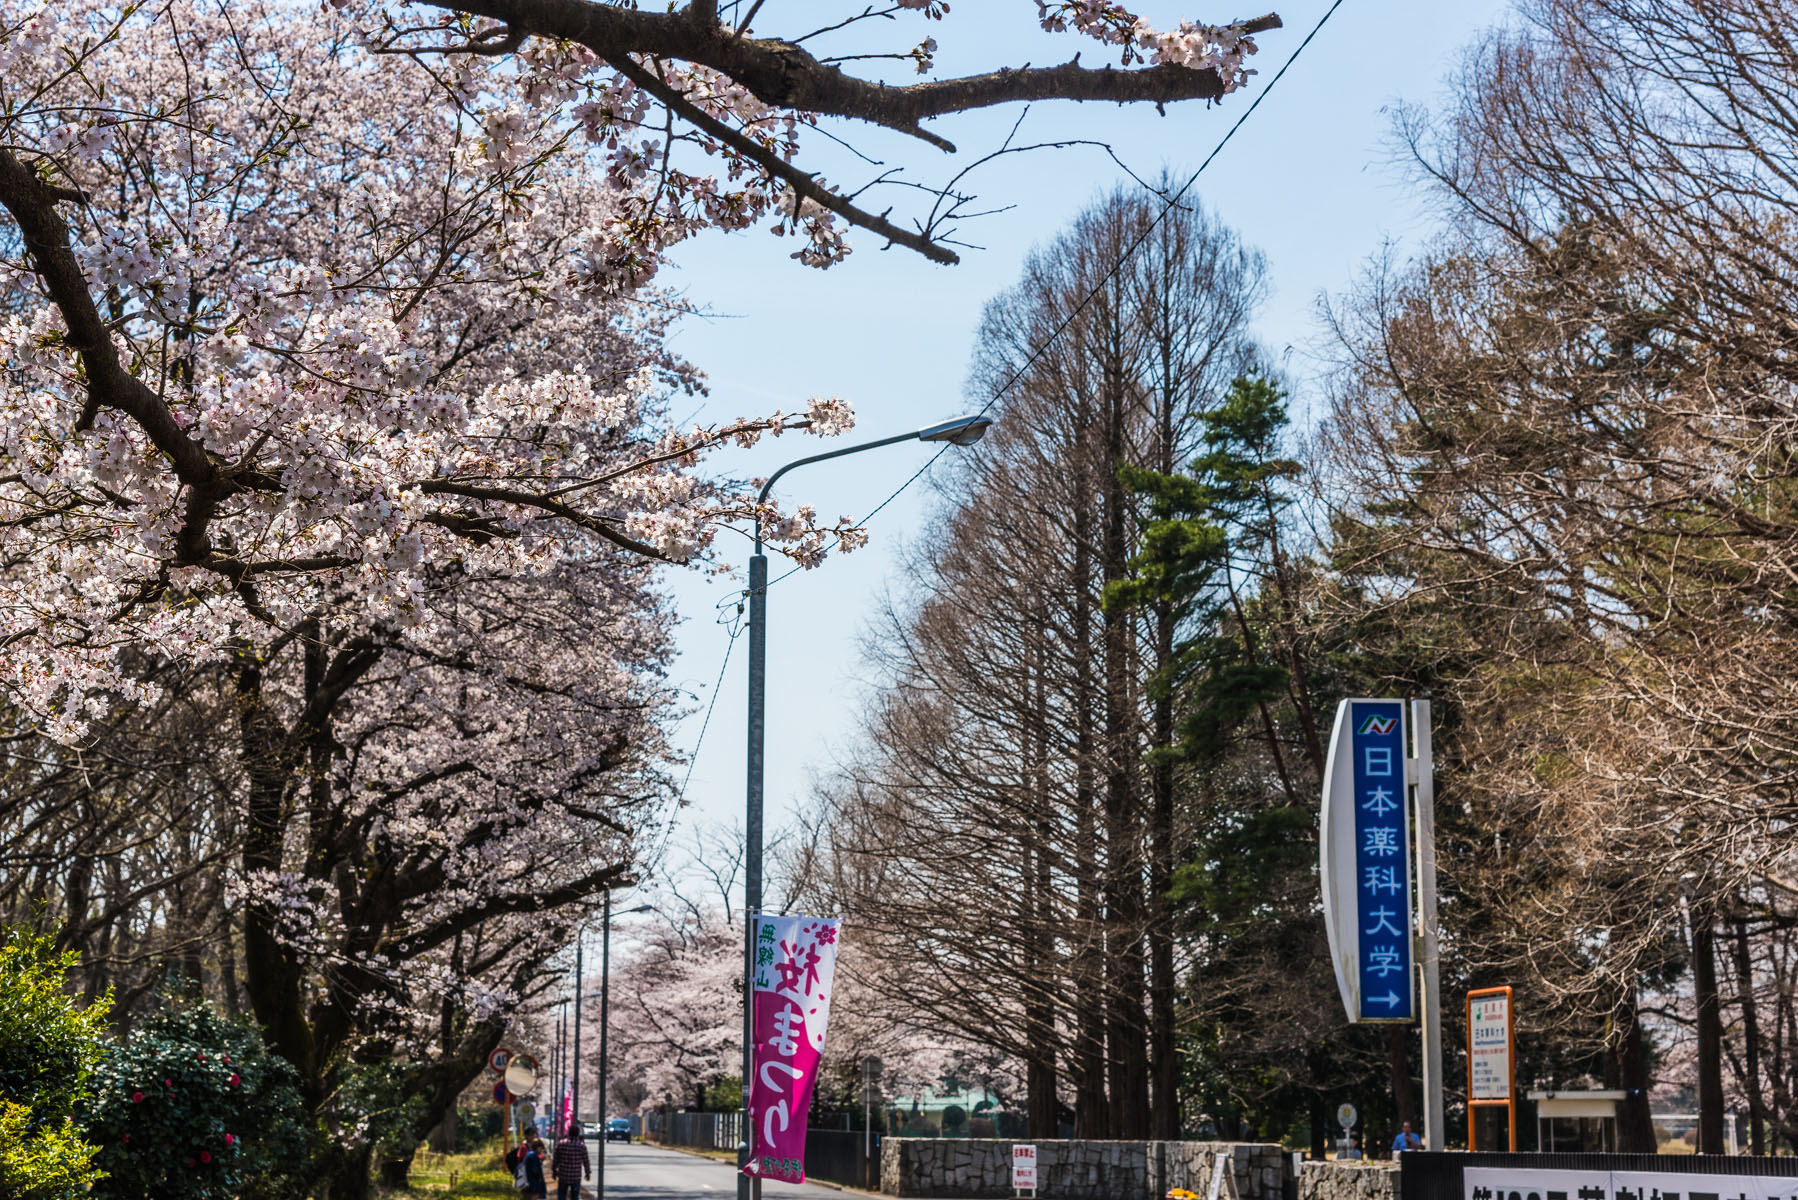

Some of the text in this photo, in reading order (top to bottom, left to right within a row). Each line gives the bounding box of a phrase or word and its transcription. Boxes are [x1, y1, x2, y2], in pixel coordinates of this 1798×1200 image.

[1361, 747, 1403, 978] 日本薬科大学
